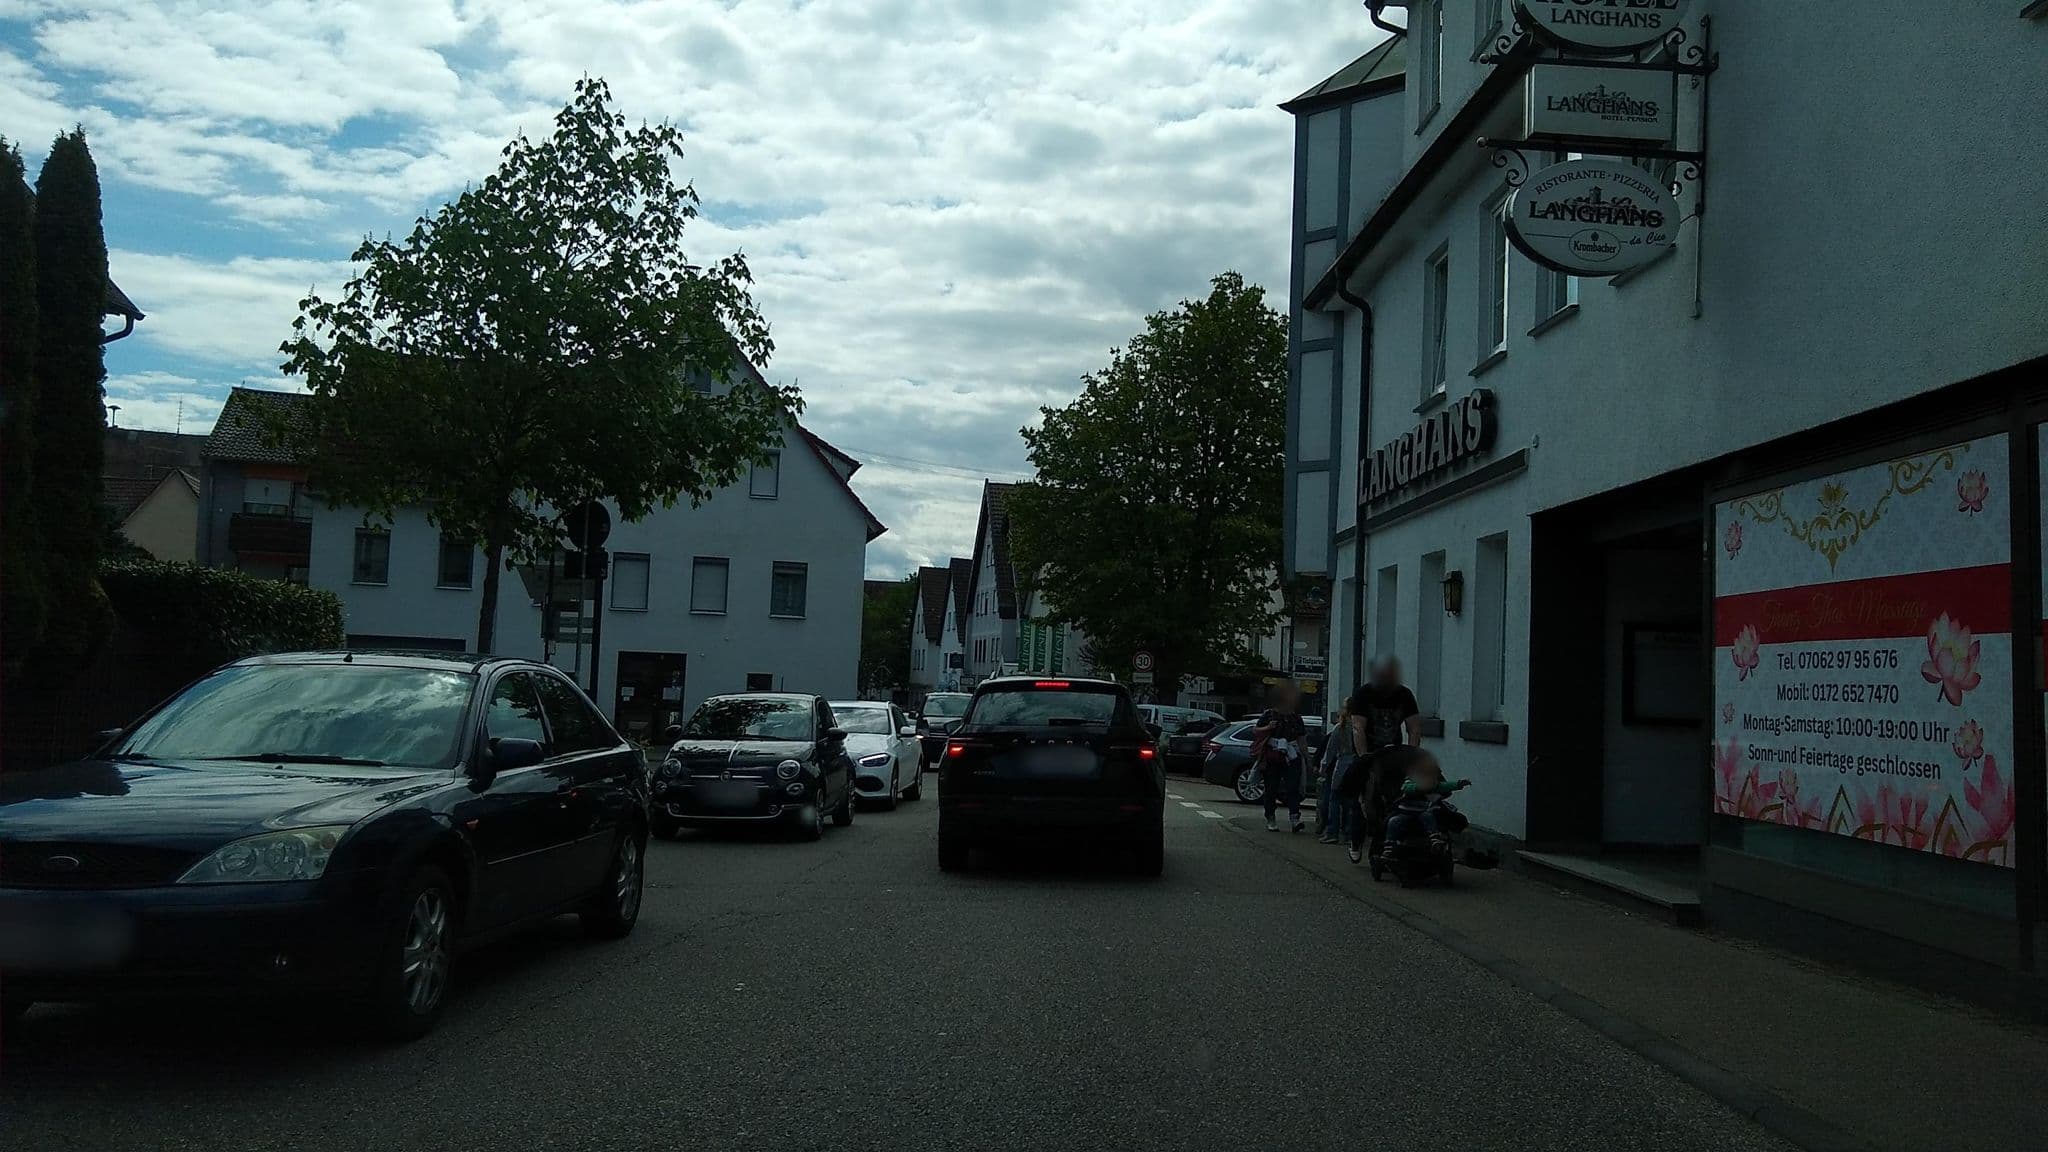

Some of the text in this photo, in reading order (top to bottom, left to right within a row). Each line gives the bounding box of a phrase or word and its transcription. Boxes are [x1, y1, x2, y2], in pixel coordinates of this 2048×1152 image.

[1551, 8, 1661, 29] LANGHANS
[1546, 96, 1659, 116] LANGHANS
[1535, 170, 1660, 203] RISTORANTE PIZZERIA
[1528, 200, 1664, 228] LANGHANS
[1573, 240, 1616, 253] Krombacher
[1358, 389, 1490, 507] LANGHANS
[1138, 656, 1149, 666] 30
[1798, 651, 1834, 669] 07062
[1837, 651, 1851, 668] 97
[1855, 650, 1870, 668] 95
[1873, 649, 1898, 668] 676
[1777, 683, 1899, 704] Mobil: 0172 652 7470
[1743, 713, 1950, 743] Montag-Samstag: 10:00-19:00 Uhr
[1748, 744, 1941, 780] Sonn-und Feiertage geschlossen
